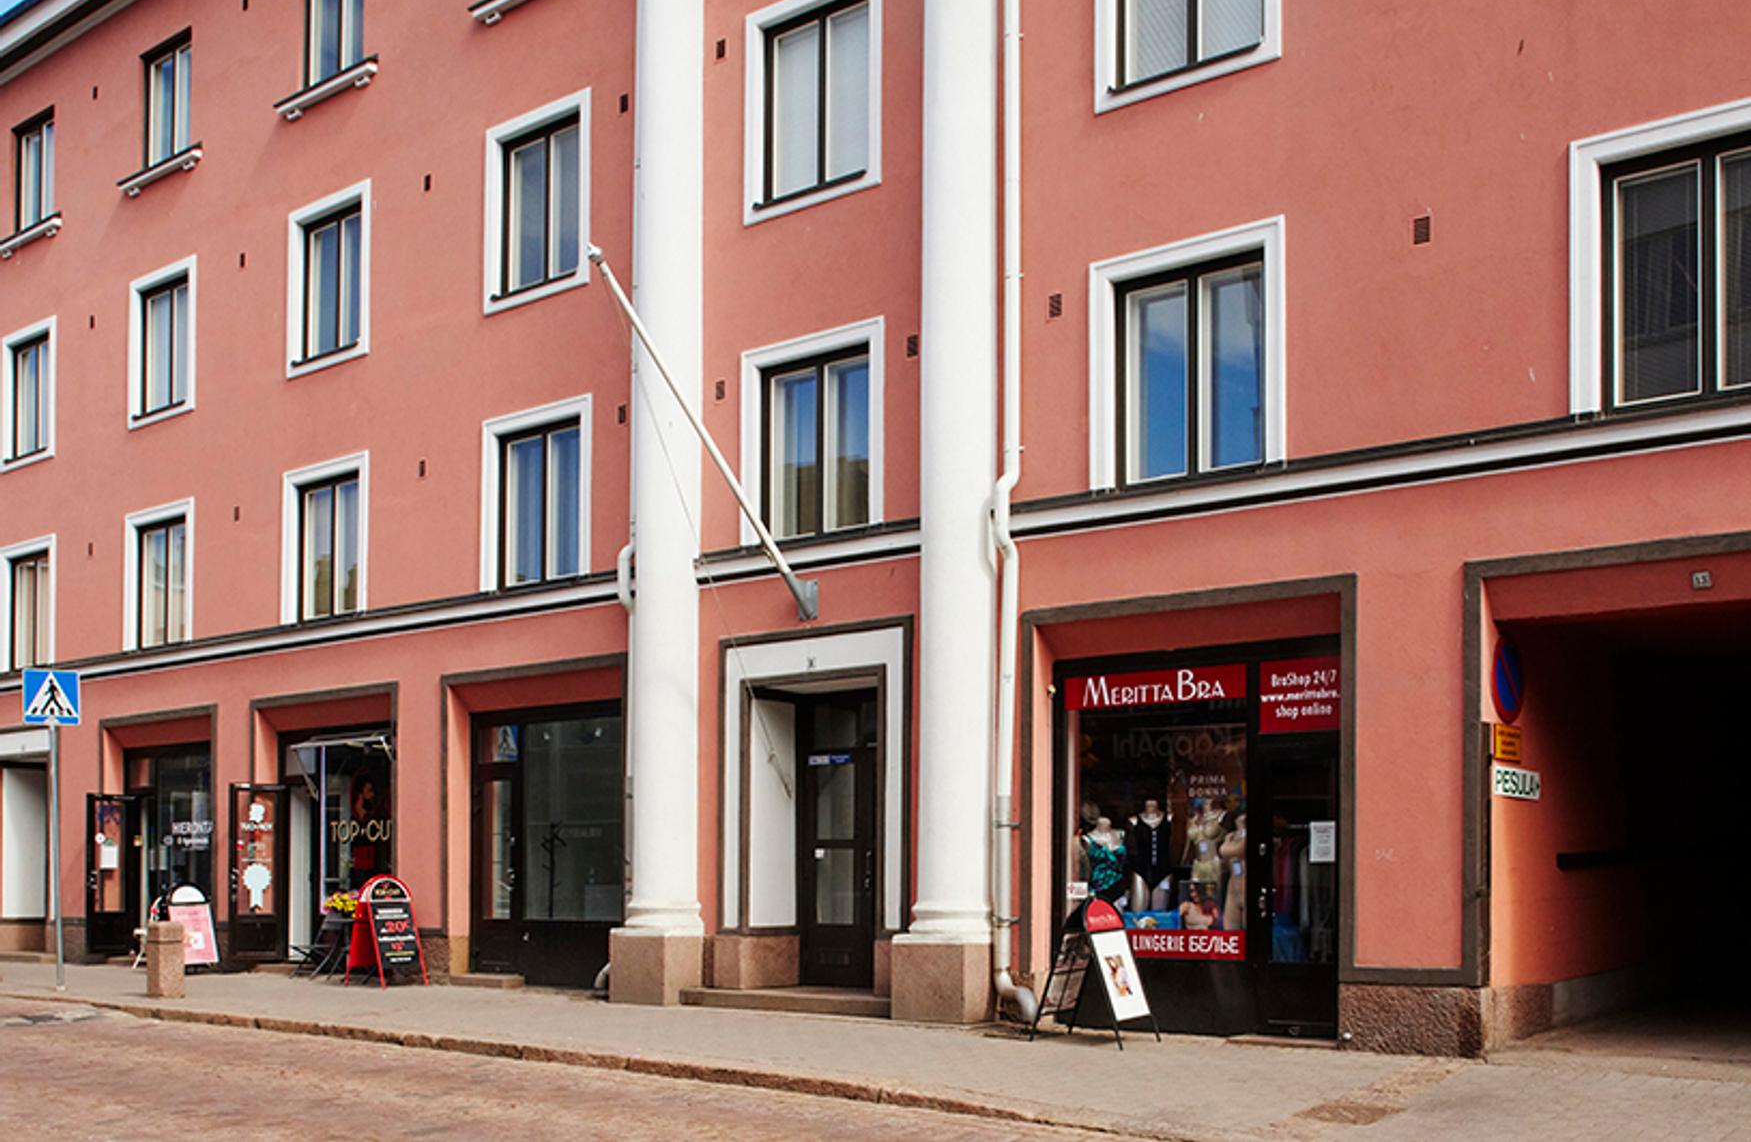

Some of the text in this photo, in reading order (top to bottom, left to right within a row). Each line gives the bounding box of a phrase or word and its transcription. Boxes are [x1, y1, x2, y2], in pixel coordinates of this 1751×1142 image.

[1275, 702, 1333, 720] shop online
[1190, 775, 1226, 785] PRIMA
[1496, 769, 1536, 797] PESULA
[1188, 787, 1227, 797] DONNA
[367, 819, 391, 843] CU
[1132, 934, 1184, 953] LINGERIE
[1188, 935, 1239, 955] БЕЛЬЕ
